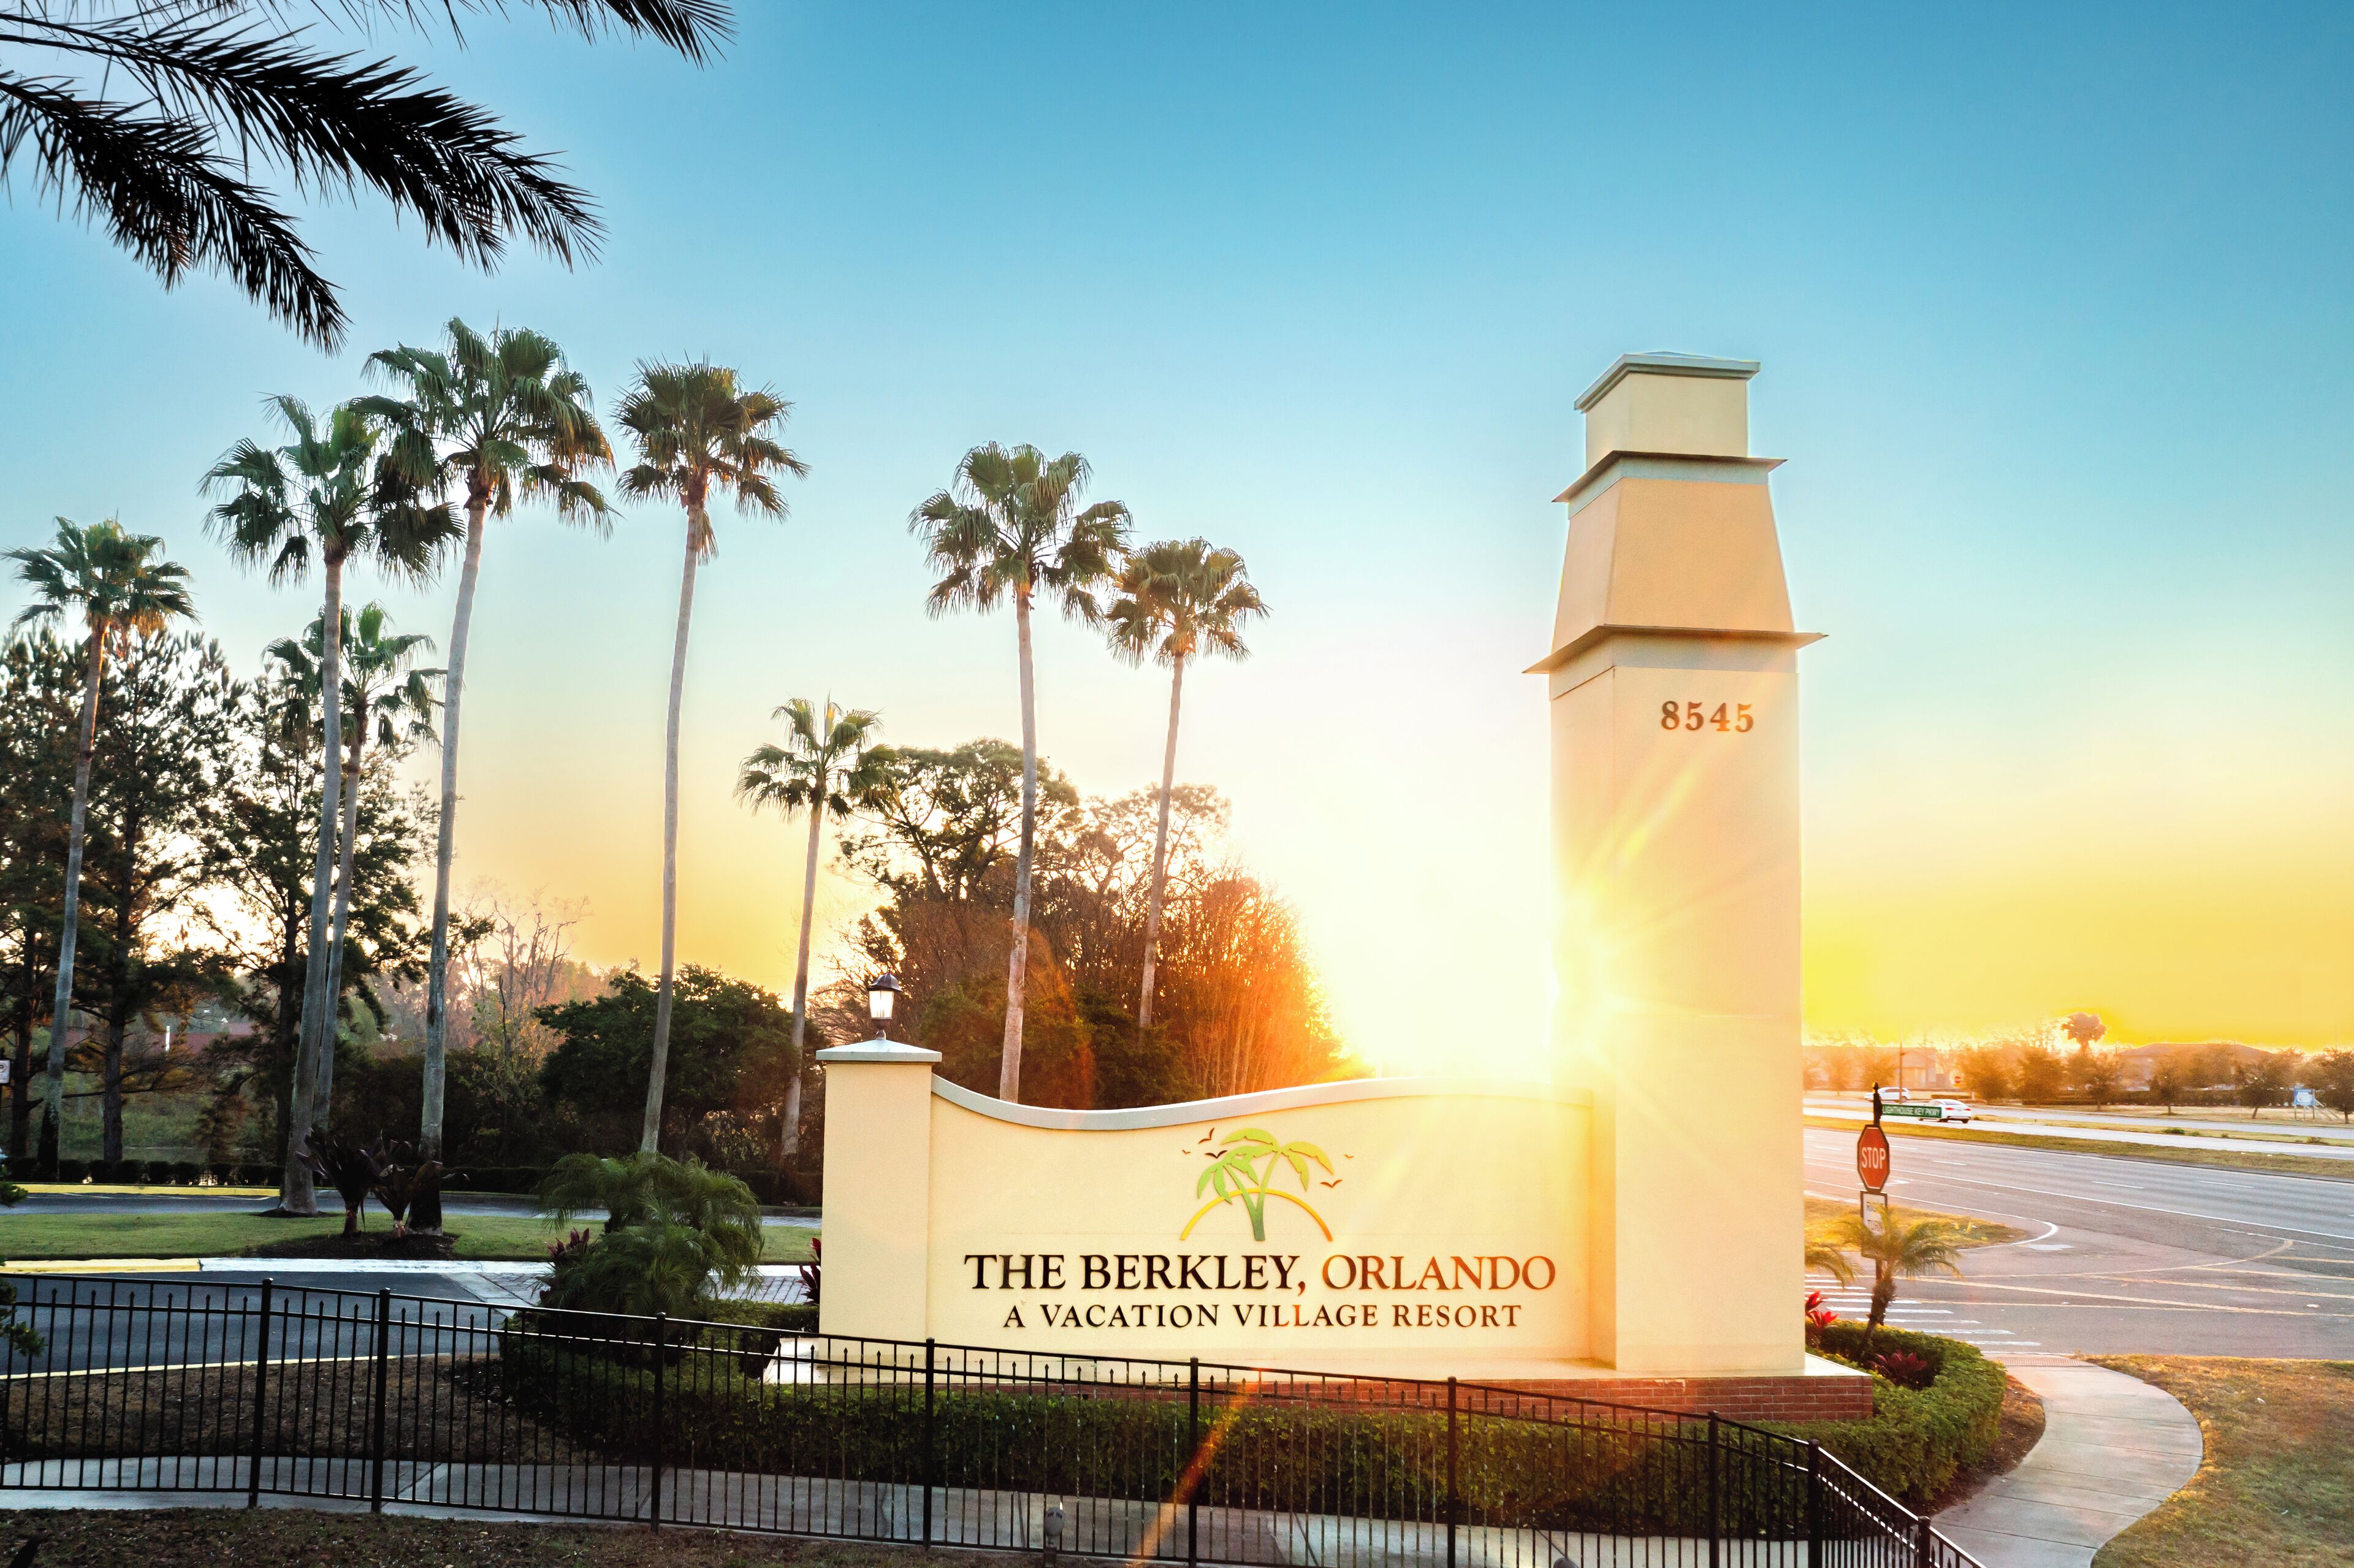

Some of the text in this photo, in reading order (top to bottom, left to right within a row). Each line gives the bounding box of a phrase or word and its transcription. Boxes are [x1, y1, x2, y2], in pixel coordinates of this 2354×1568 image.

[1661, 700, 1754, 733] 8545
[1883, 1106, 1940, 1116] LIGHTHOUSE KEY PKWY
[1861, 1147, 1886, 1169] STOP
[964, 1254, 1556, 1298] THE BERKLEY, ORLANDO
[1002, 1304, 1522, 1330] A VACATION VILLAGE RESORT
